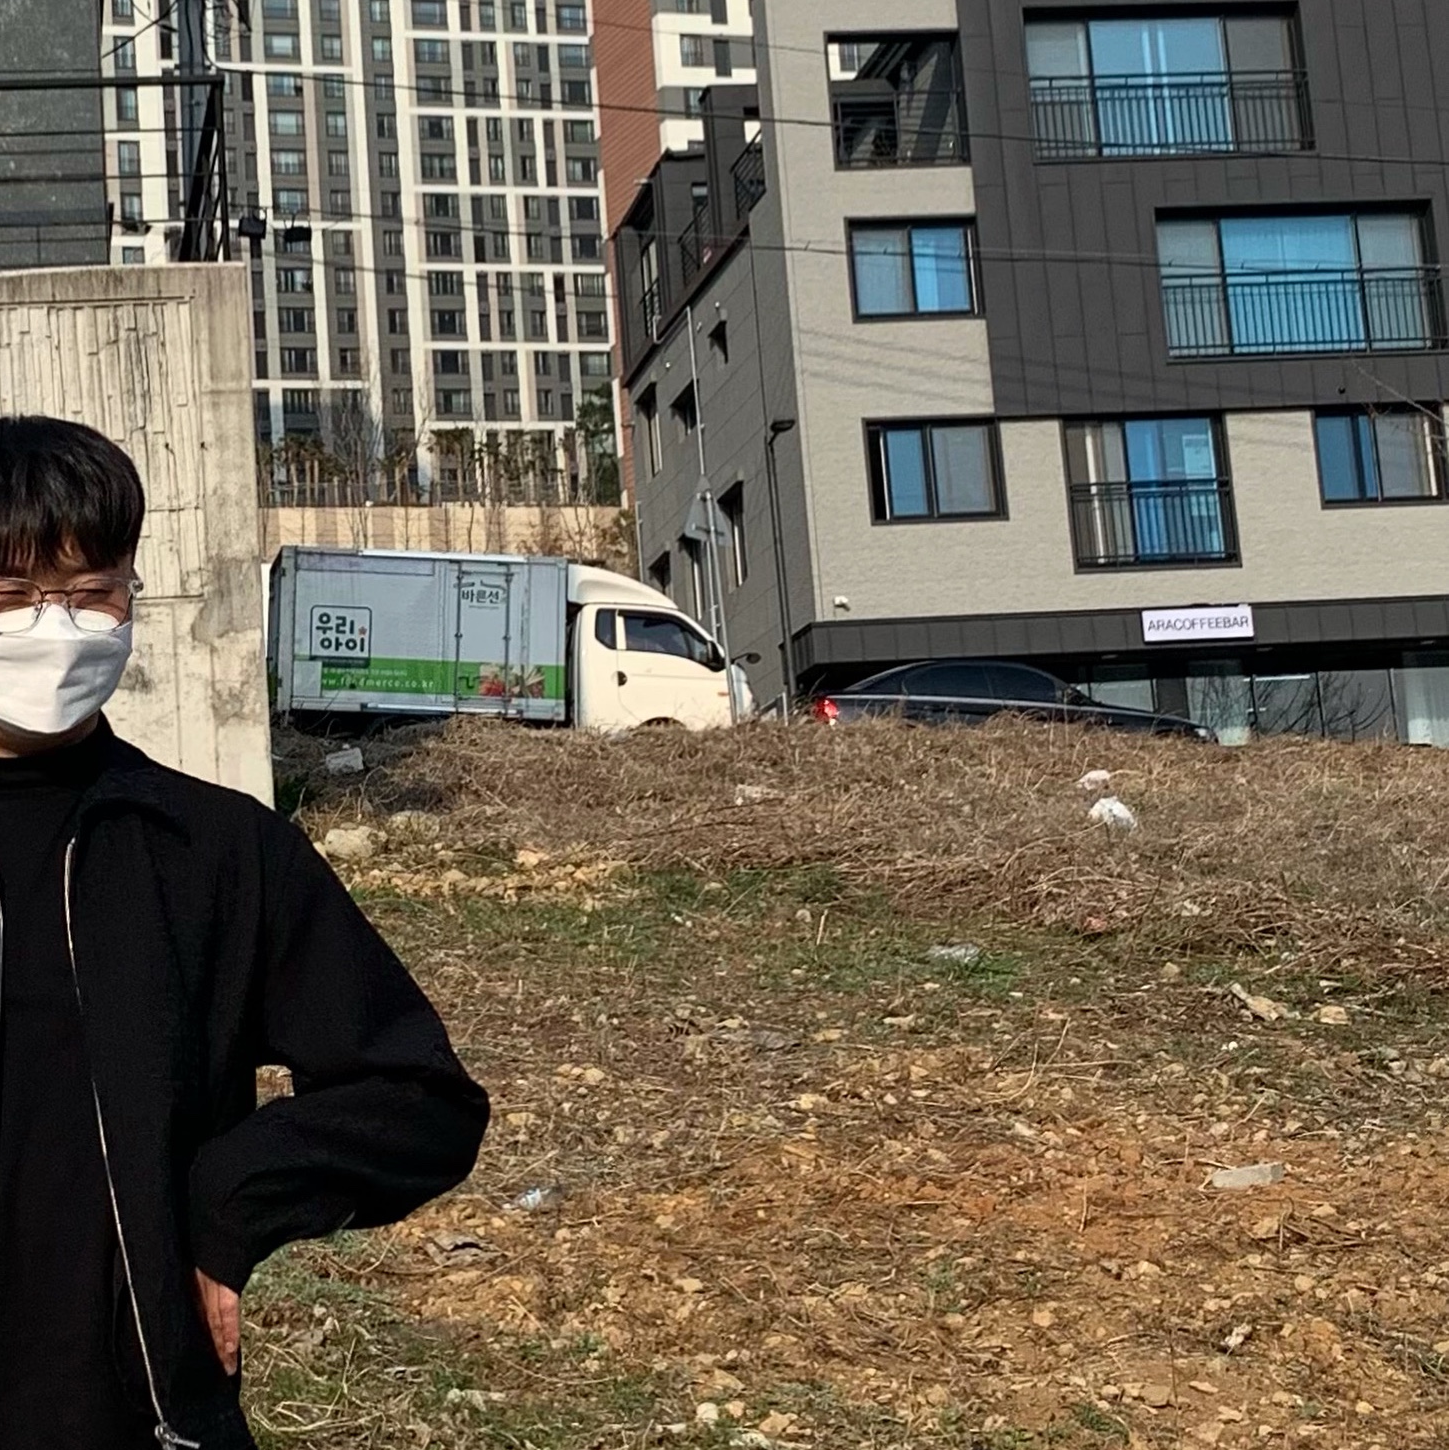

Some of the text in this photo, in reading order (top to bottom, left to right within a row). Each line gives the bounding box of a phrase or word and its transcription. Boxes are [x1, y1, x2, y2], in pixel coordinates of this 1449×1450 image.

[461, 589, 500, 604] 바른선
[315, 612, 355, 635] 우리
[1147, 615, 1249, 632] ARACOFFEEBAR
[319, 636, 365, 652] 아이
